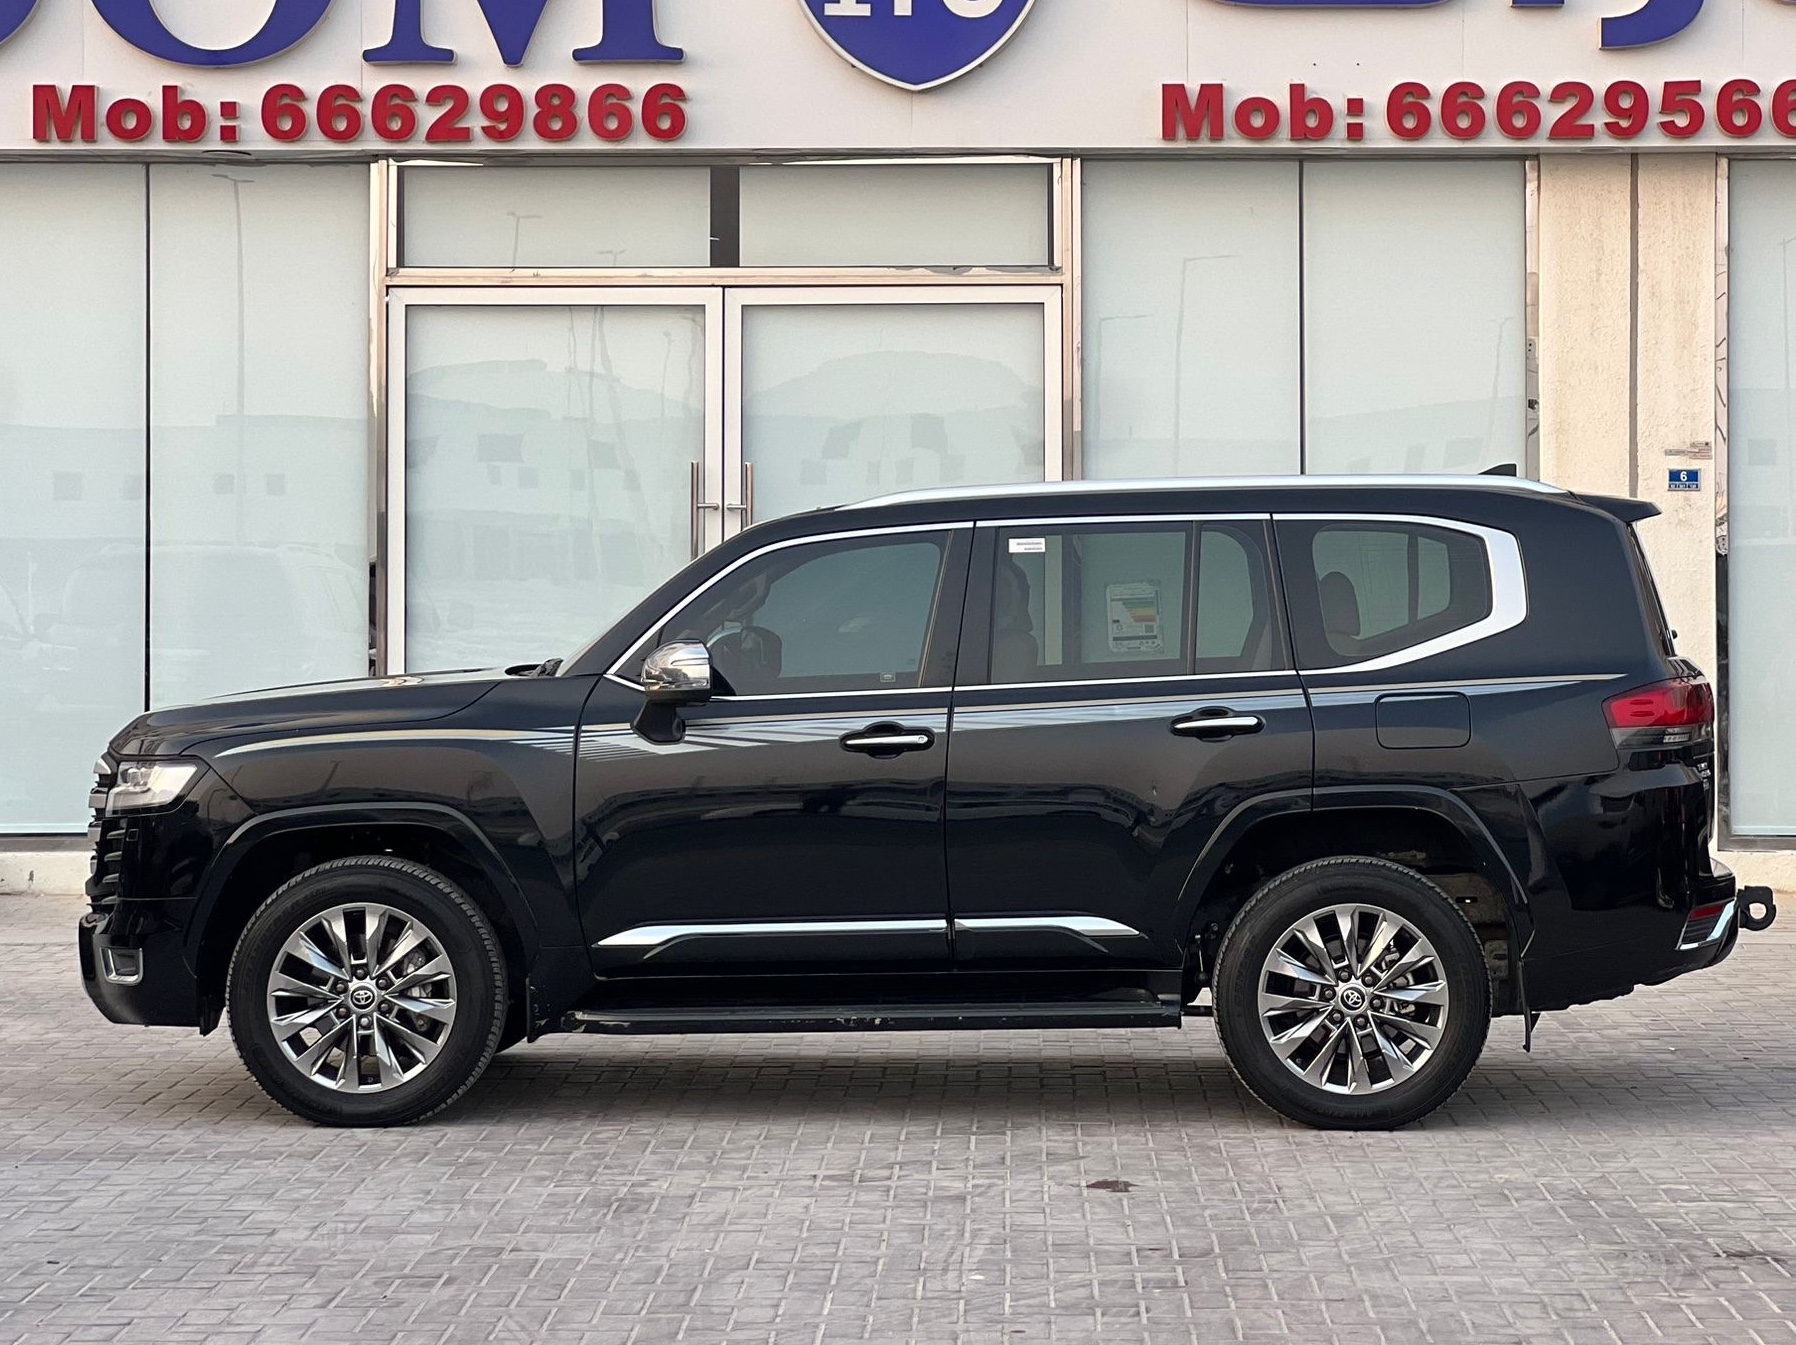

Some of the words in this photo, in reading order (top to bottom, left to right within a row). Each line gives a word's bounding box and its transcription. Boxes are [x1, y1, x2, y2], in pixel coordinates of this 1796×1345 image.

[32, 84, 239, 142] Mob:
[261, 83, 687, 141] 66629866
[1161, 82, 1365, 140] Mob:
[1680, 471, 1688, 481] 6
